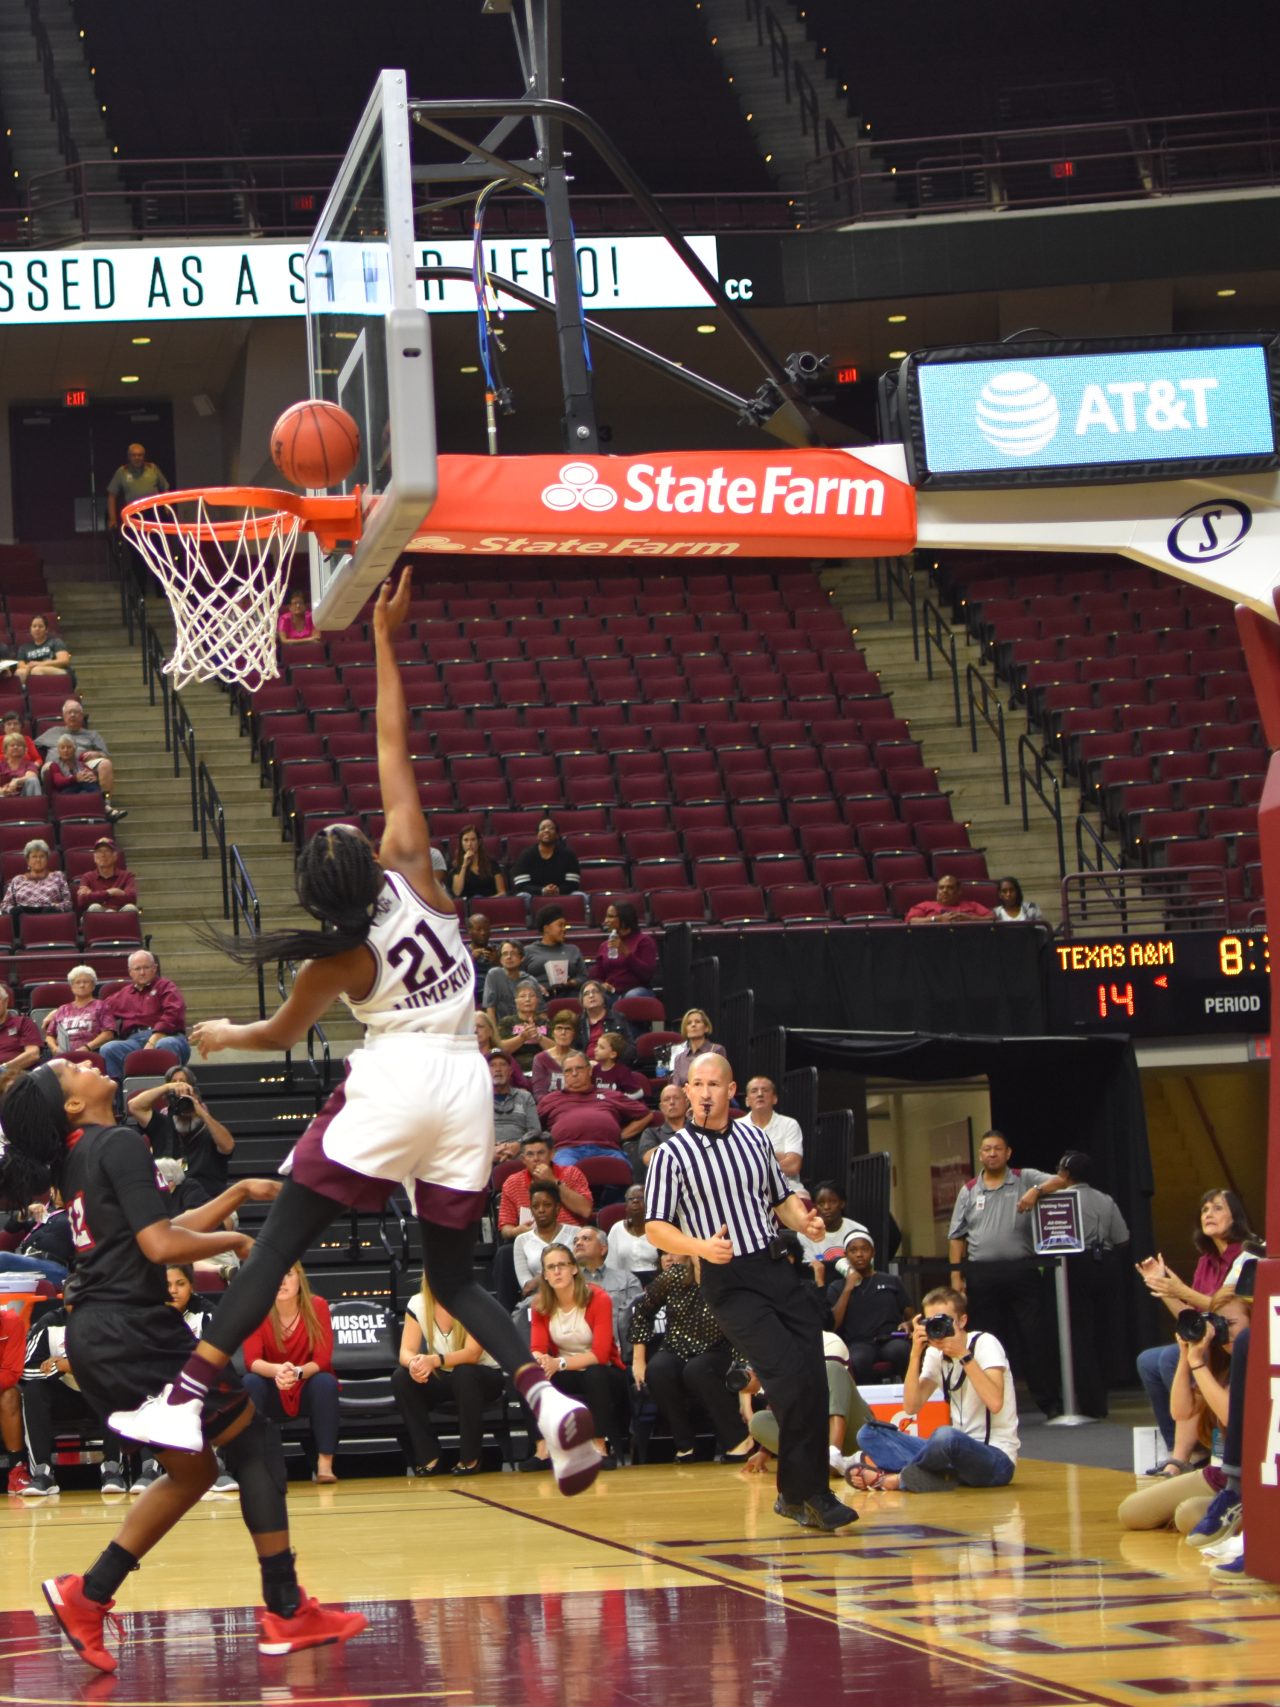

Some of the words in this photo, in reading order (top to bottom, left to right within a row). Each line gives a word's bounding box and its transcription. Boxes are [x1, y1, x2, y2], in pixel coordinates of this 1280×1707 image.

[148, 255, 204, 308] AS
[235, 254, 259, 306] A
[1074, 377, 1218, 436] AT&T
[386, 919, 457, 995] 21
[1056, 945, 1126, 971] TEXAS
[1131, 941, 1175, 967] A&M
[393, 958, 472, 1010] UMPKIN
[1097, 982, 1135, 1018] 14
[1204, 995, 1262, 1014] PERIOD
[330, 1314, 387, 1331] MUSCLE
[337, 1328, 378, 1345] MILK
